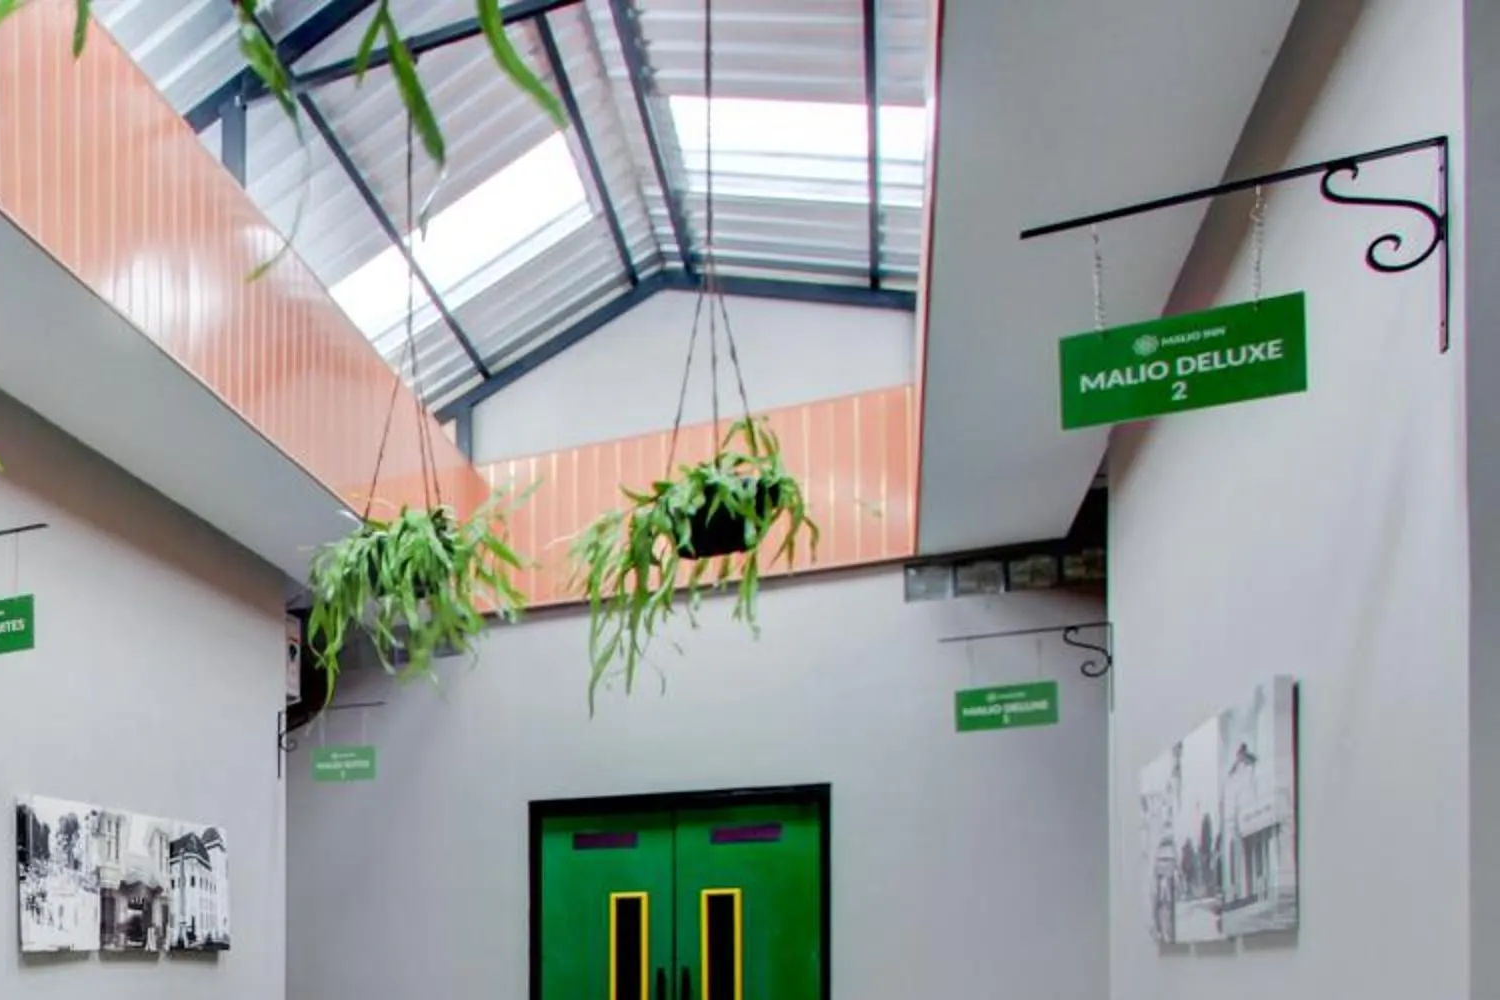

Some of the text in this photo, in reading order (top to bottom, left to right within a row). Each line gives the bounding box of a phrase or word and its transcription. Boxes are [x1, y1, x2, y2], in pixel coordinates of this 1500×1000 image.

[1080, 339, 1283, 393] MALIO DELUXE
[1172, 381, 1188, 400] 2
